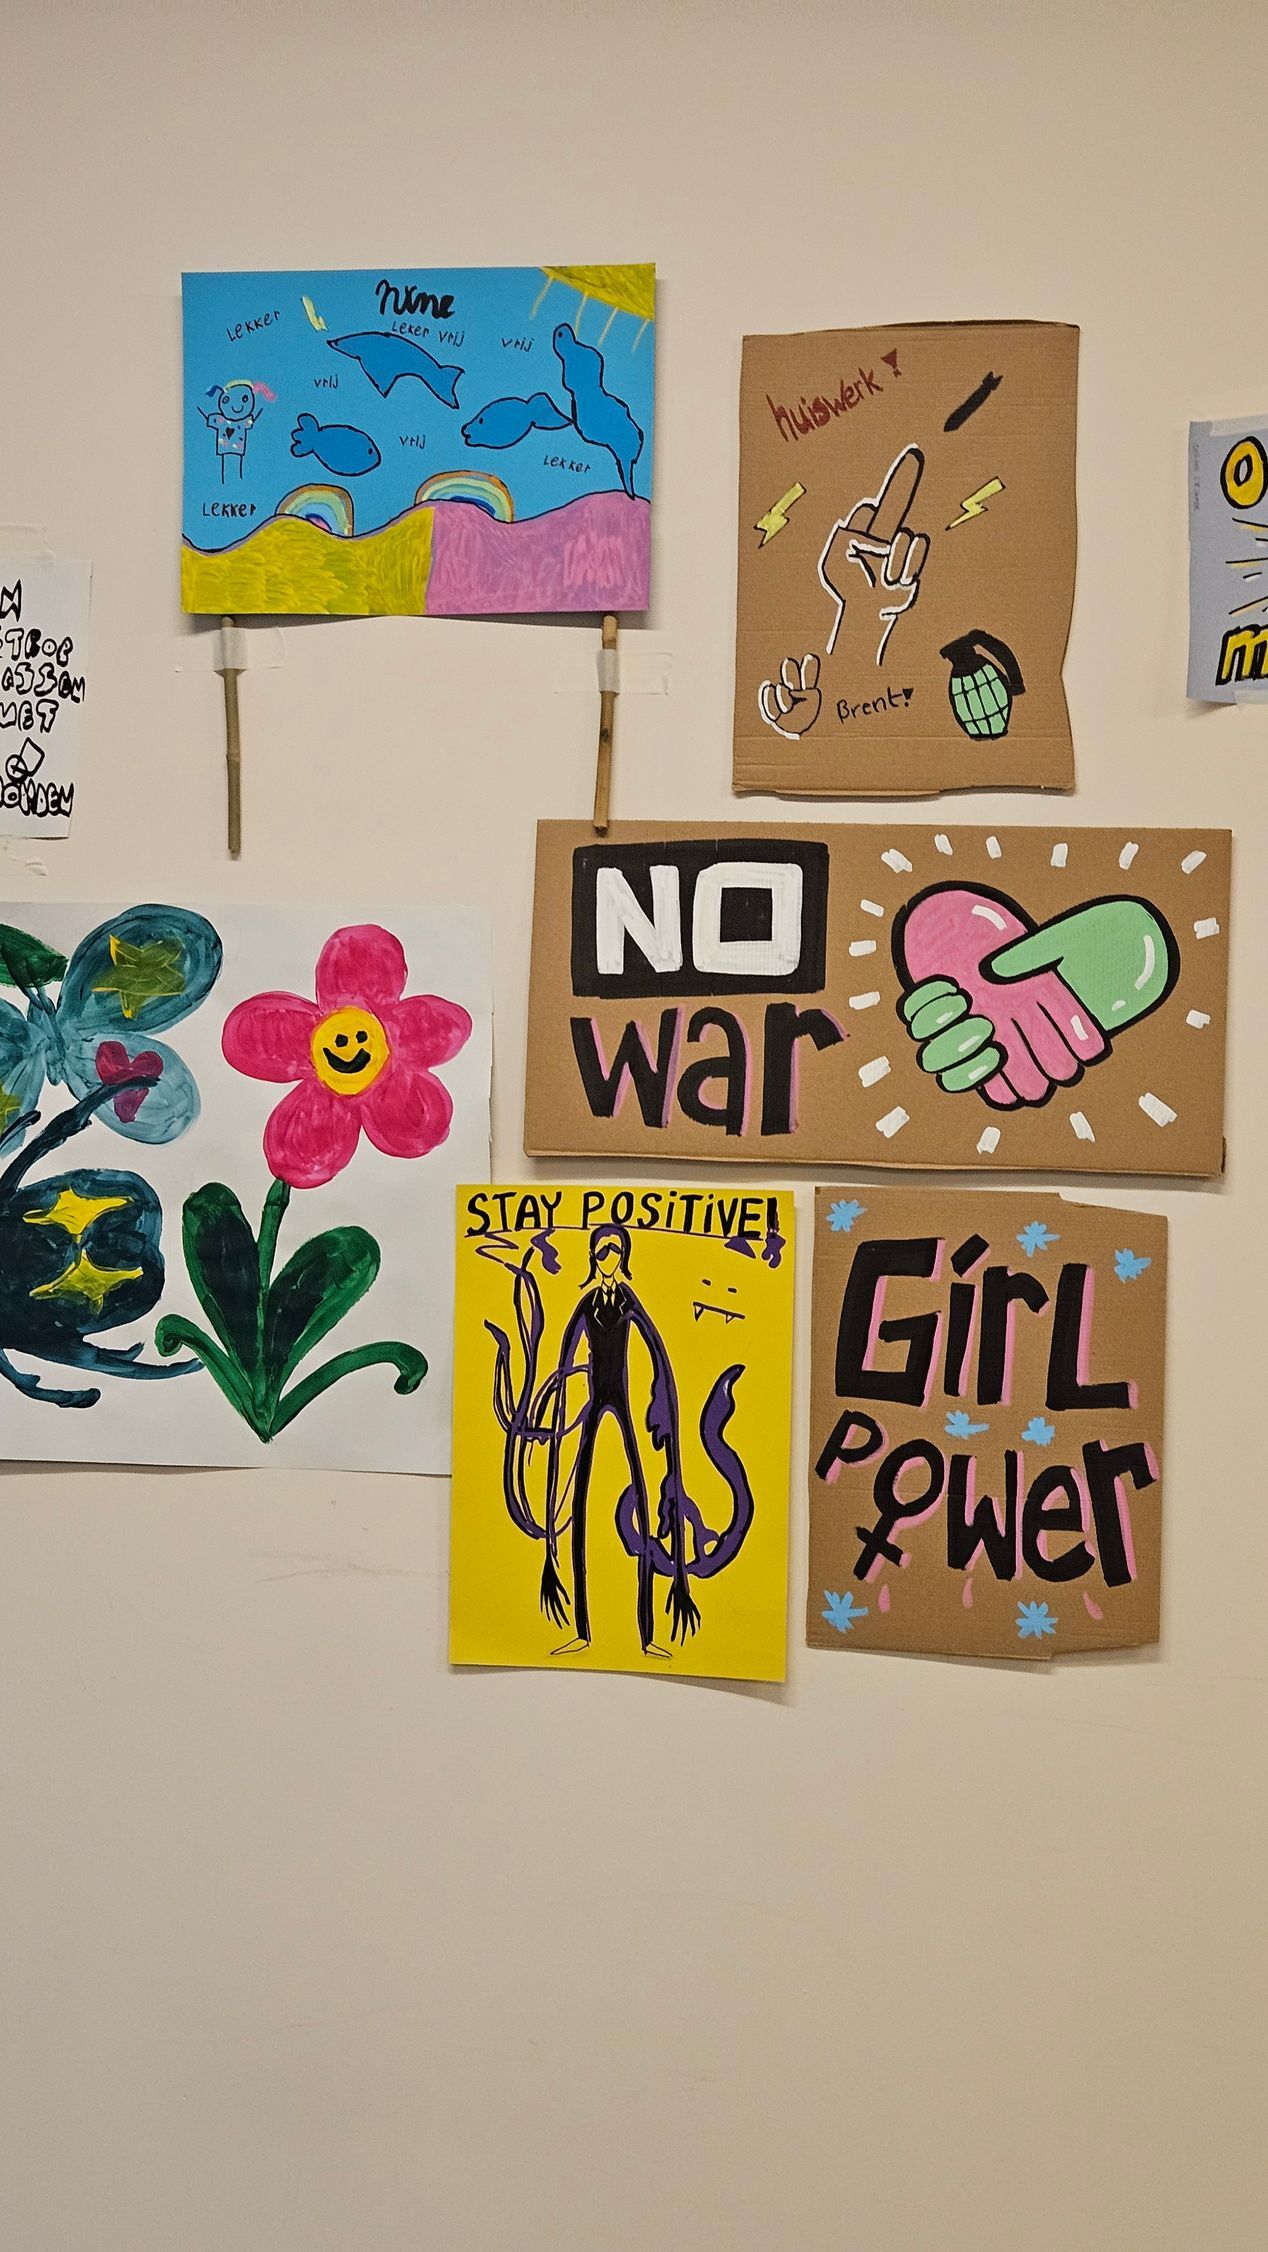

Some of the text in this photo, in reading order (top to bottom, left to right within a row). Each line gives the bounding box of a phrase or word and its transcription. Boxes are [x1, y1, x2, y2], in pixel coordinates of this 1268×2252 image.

[596, 861, 803, 976] NO
[570, 1002, 850, 1137] war
[466, 1191, 562, 1236] STAY
